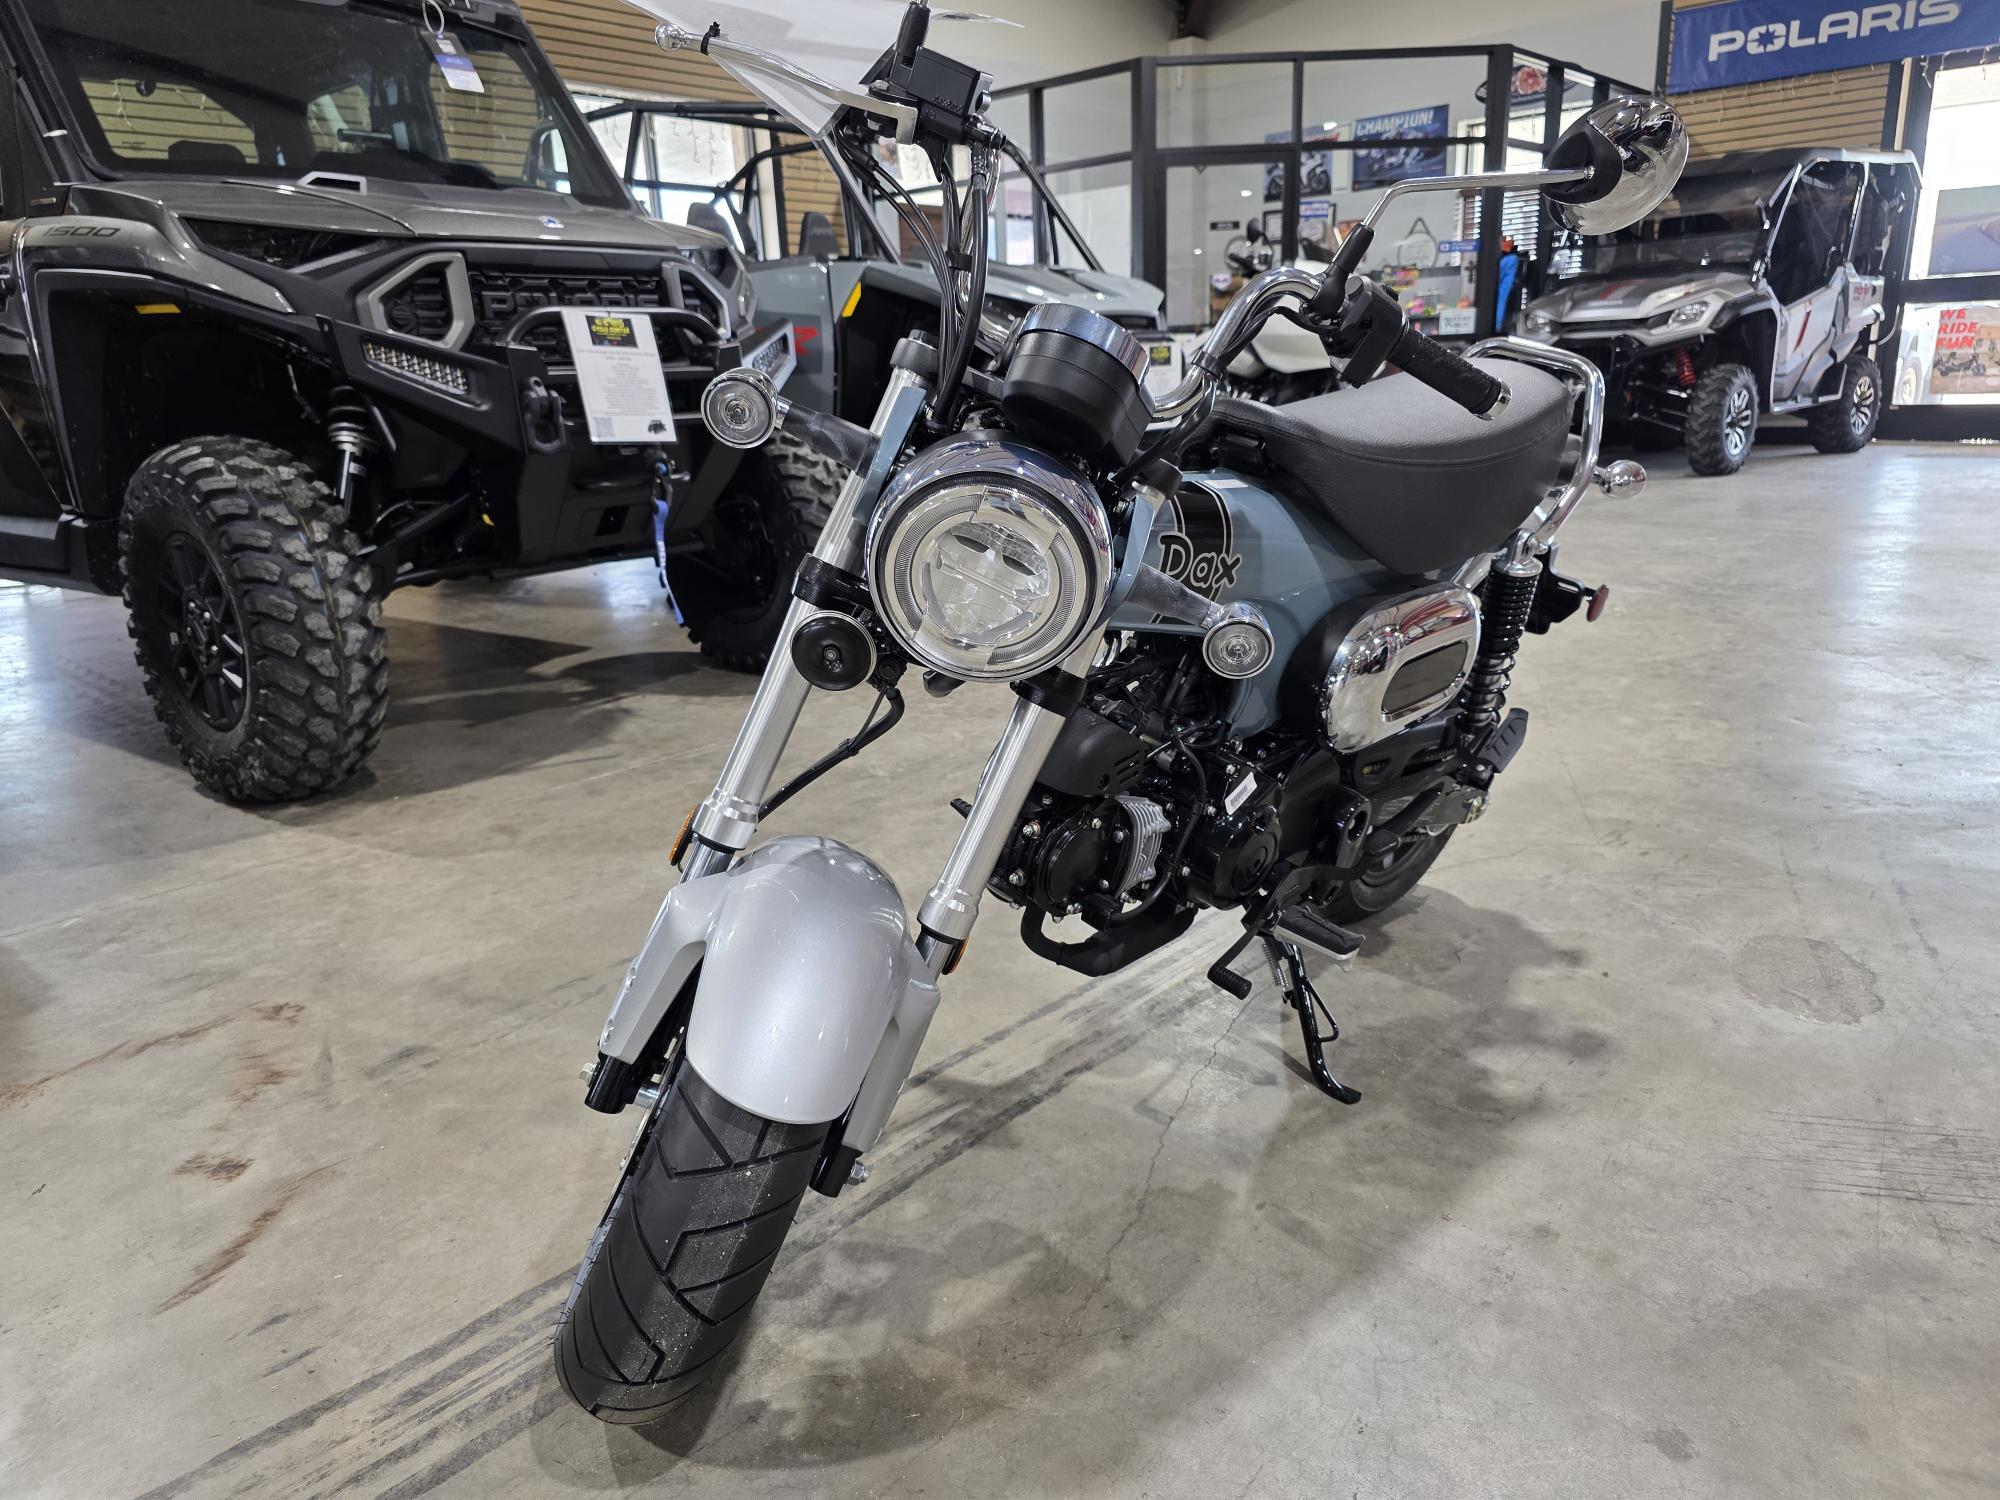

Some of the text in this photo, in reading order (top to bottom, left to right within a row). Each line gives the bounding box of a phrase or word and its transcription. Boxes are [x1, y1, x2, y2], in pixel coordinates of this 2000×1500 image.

[1707, 0, 1960, 62] POLARIS
[43, 226, 121, 238] 1500
[1940, 309, 1966, 319] WE
[1938, 321, 1978, 334] RIDE
[1158, 531, 1243, 589] Dax
